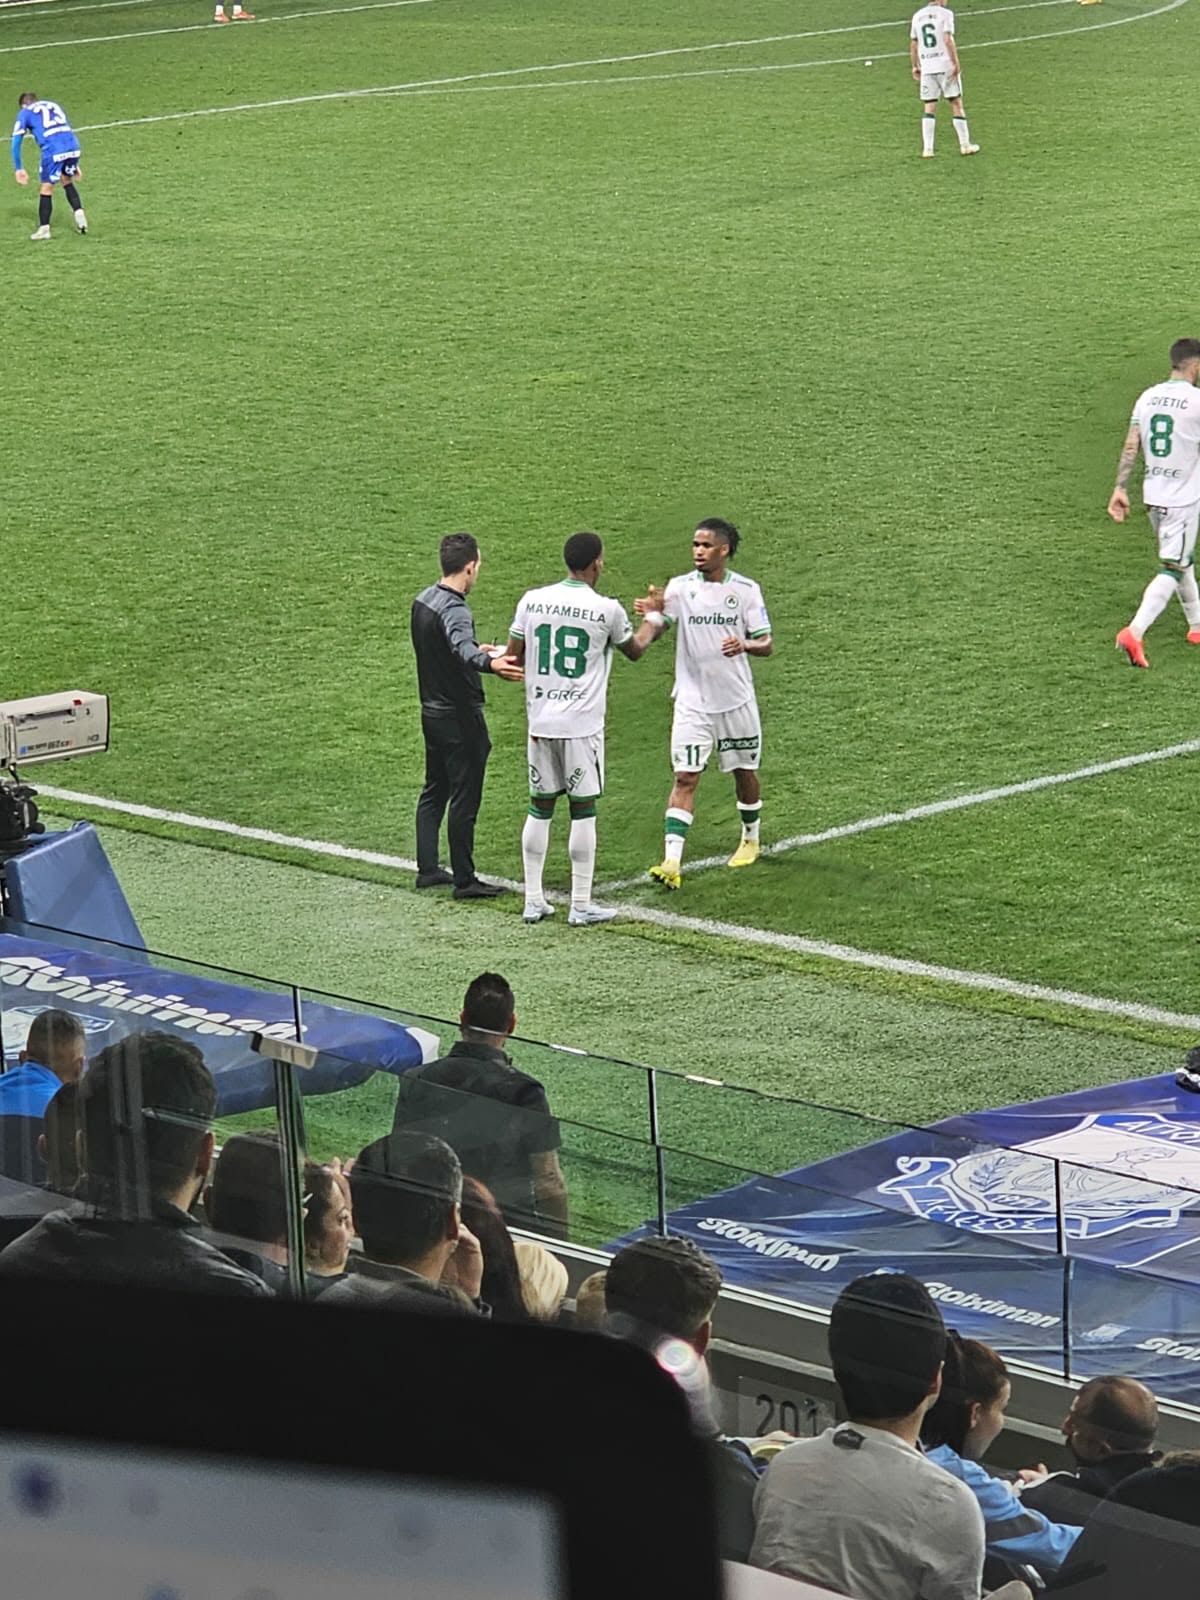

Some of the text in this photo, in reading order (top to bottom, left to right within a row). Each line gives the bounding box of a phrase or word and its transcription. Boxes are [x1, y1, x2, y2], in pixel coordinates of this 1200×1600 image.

[921, 23, 937, 48] 6
[33, 104, 67, 128] 23
[1150, 413, 1174, 458] 8
[526, 603, 606, 623] MAYAMBELA
[688, 612, 739, 626] novibet
[534, 623, 590, 679] 18
[685, 744, 700, 766] 11
[1135, 1337, 1200, 1361] Stoi
[756, 1394, 818, 1437] 201
